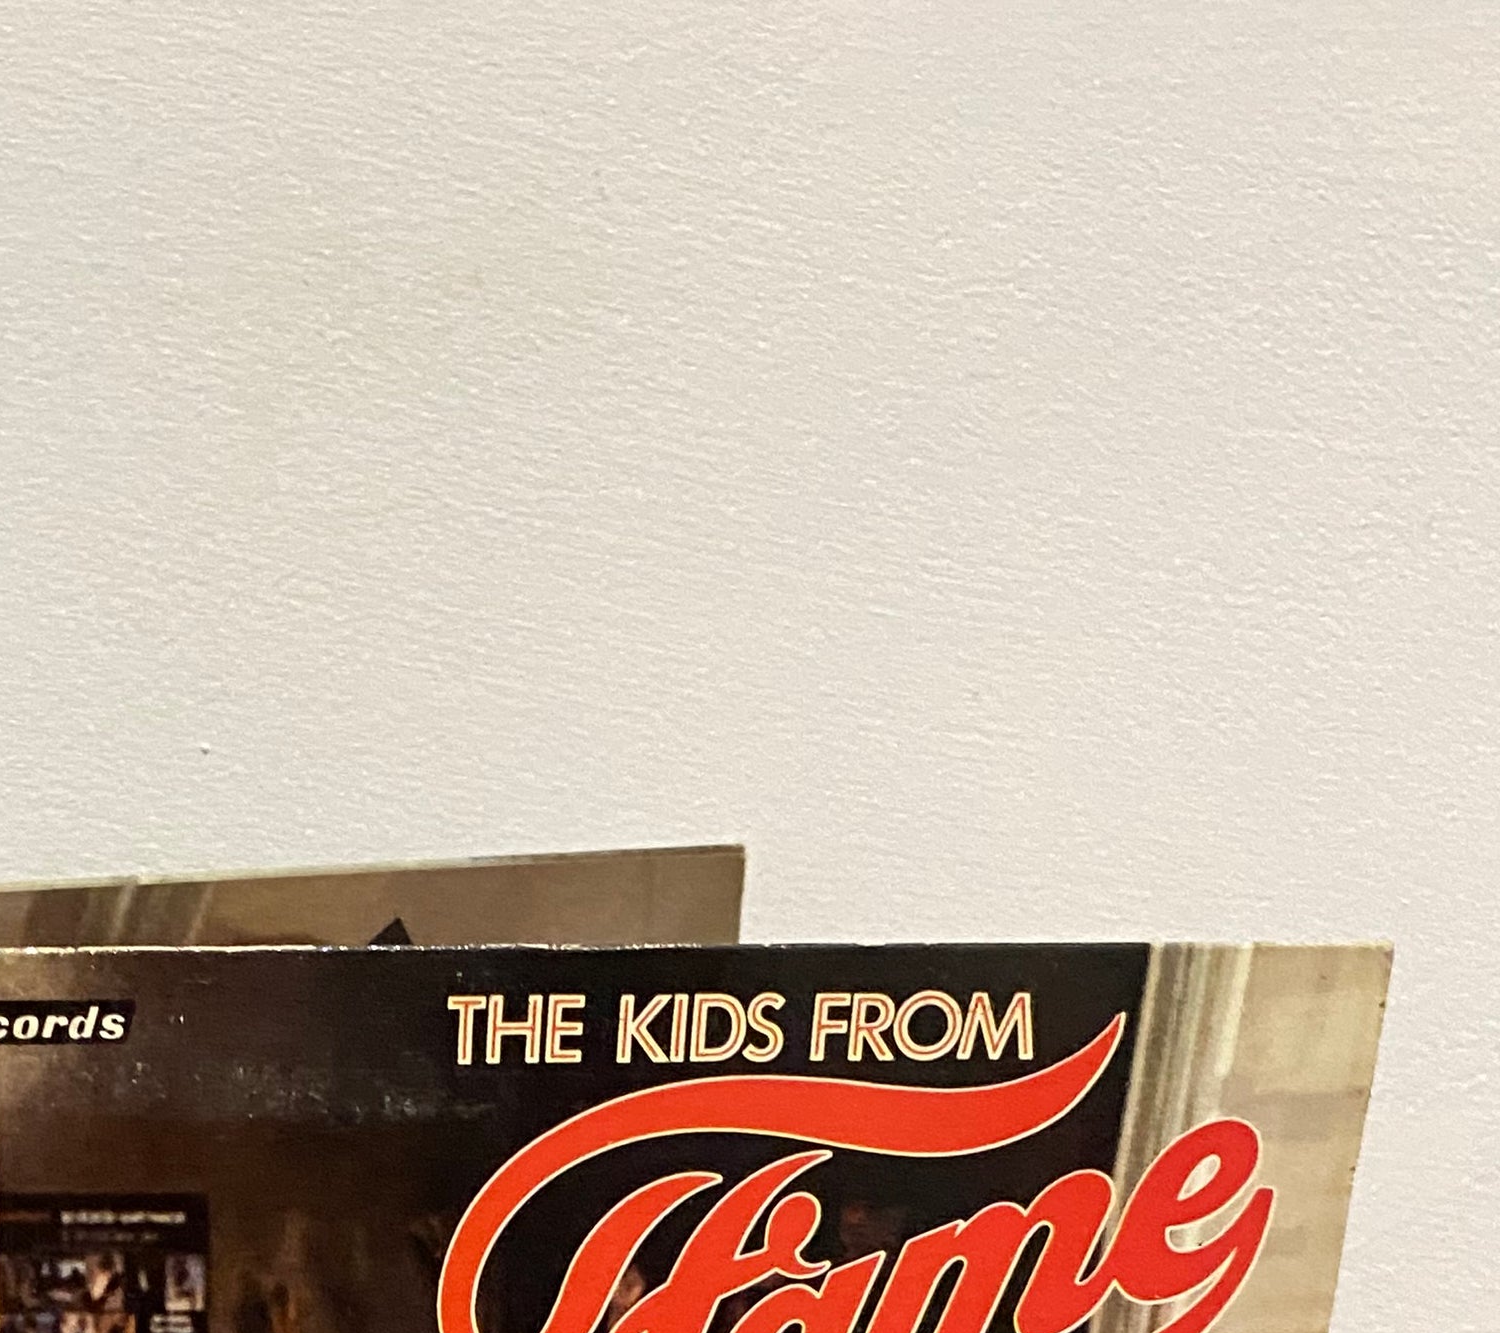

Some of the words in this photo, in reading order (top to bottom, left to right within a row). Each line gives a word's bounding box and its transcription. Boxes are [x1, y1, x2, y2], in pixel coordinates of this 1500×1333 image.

[447, 994, 586, 1066] THE
[615, 991, 787, 1064] KIDS
[808, 990, 1034, 1062] FROM
